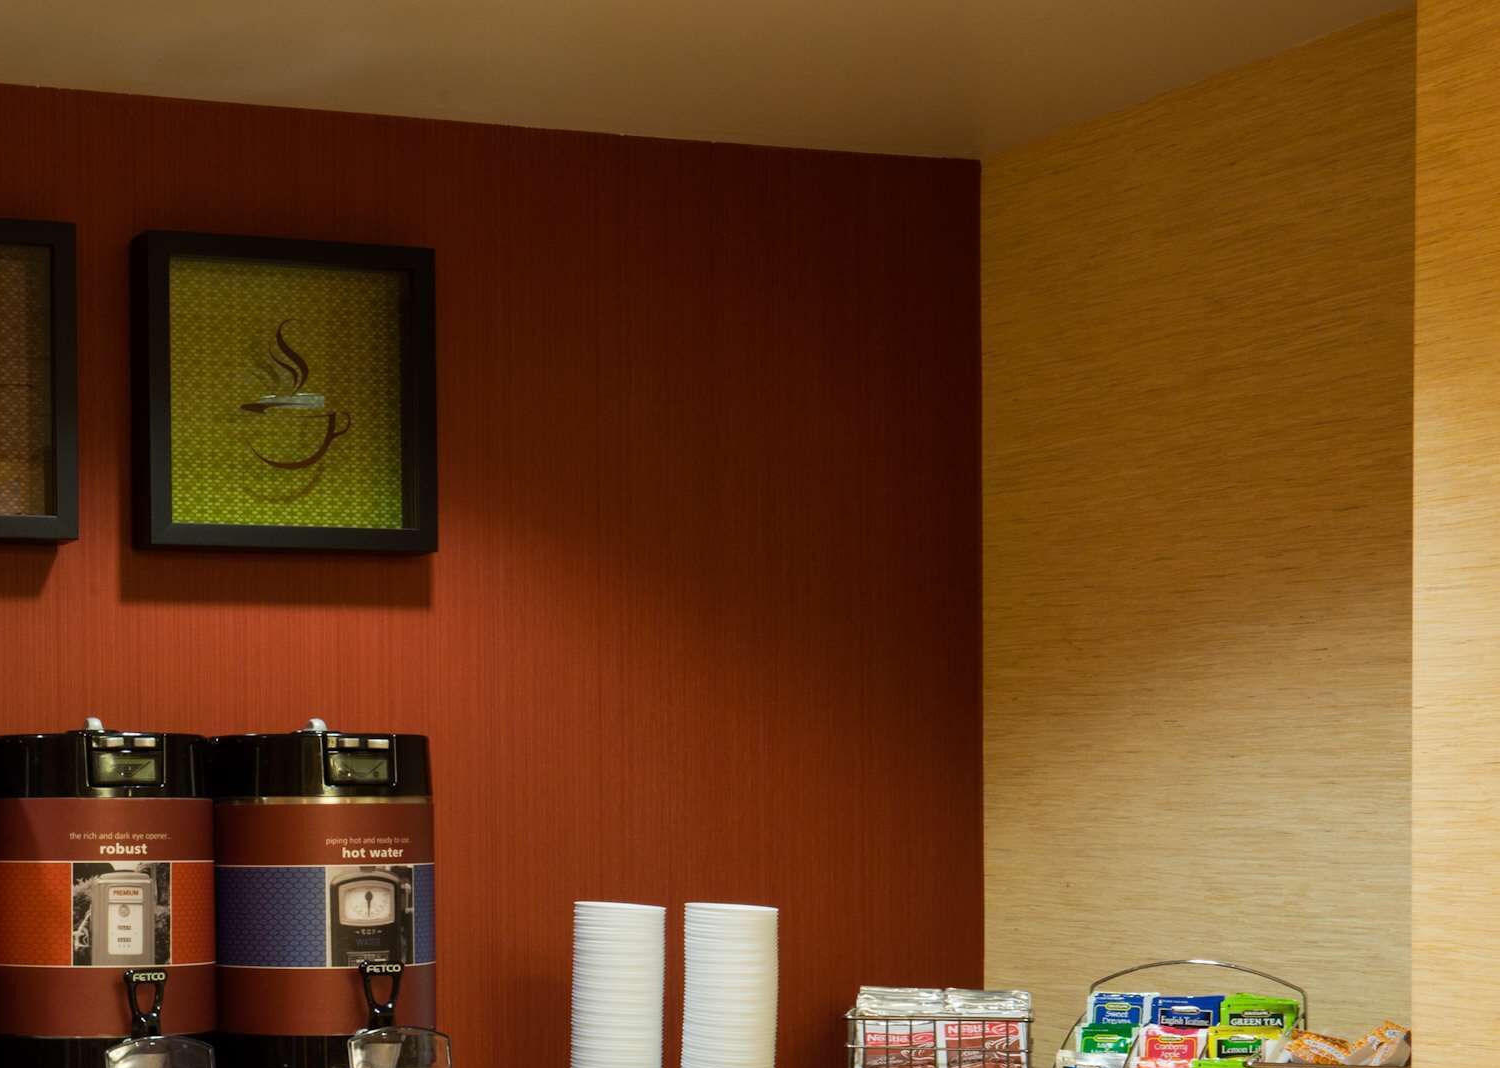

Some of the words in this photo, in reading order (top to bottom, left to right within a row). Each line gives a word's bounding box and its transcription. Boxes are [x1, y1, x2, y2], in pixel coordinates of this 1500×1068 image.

[69, 832, 82, 840] the
[83, 832, 97, 840] rich
[98, 832, 114, 840] and
[114, 832, 131, 840] dark
[132, 833, 144, 841] eye
[325, 837, 349, 846] piping
[349, 836, 362, 844] hot
[362, 836, 376, 844] and
[376, 836, 394, 846] ready
[100, 842, 148, 855] robust
[342, 847, 366, 859] hot
[369, 847, 404, 858] water
[112, 889, 140, 897] PREMIUM
[366, 964, 402, 973] FETCO
[132, 972, 167, 982] FETCO
[1161, 1016, 1184, 1026] English
[1185, 1016, 1209, 1026] Teatime
[1230, 1017, 1262, 1027] GREEN
[1263, 1016, 1284, 1026] TEA
[1155, 1044, 1188, 1053] Cranberry
[1221, 1045, 1248, 1054] Lemon
